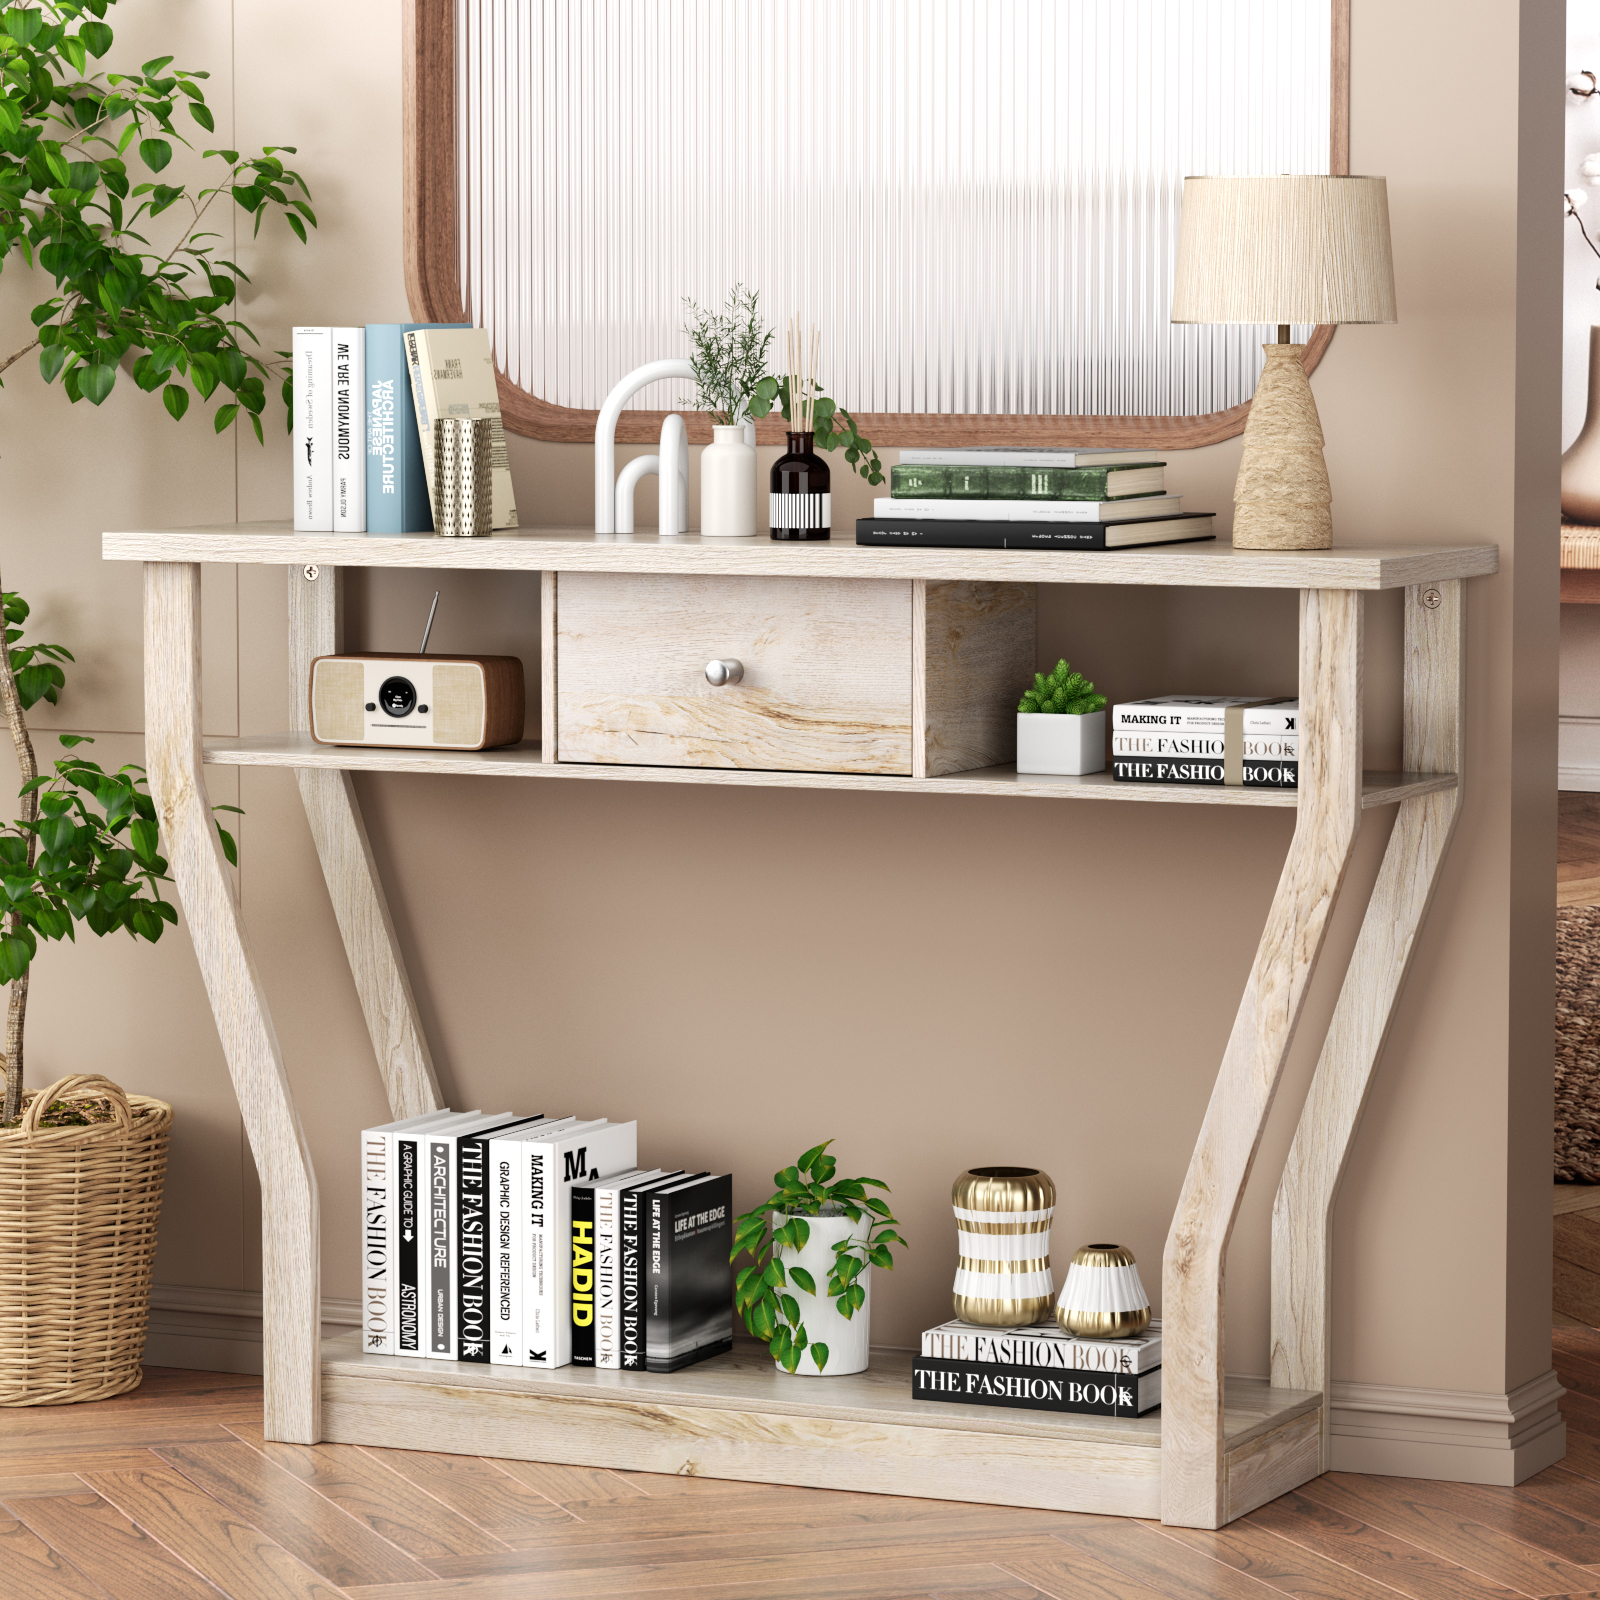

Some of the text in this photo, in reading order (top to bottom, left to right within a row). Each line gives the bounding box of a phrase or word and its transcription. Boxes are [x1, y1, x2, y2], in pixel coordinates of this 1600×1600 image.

[1121, 714, 1182, 725] MAKING IT
[1114, 737, 1296, 757] THE FASHIO BOOK
[1114, 762, 1296, 783] THE FASHIO BOOK
[403, 1151, 413, 1189] GRAPHIC
[499, 1161, 510, 1208] GRAPHIC
[531, 1154, 544, 1227] MAKING IT
[403, 1190, 414, 1219] GUIDE
[403, 1219, 414, 1229] TO
[433, 1155, 447, 1268] ARCHITECTURE
[674, 1217, 688, 1234] LIFE
[688, 1214, 697, 1230] AT
[696, 1211, 709, 1226] THE
[708, 1205, 726, 1222] EDGE
[366, 1136, 388, 1348] THE FASHION BOOK
[461, 1142, 484, 1357] THE FASHION BOOK
[500, 1211, 510, 1249] DESIGN
[652, 1199, 661, 1274] LIFE AT THE EDGE
[500, 1252, 511, 1321] REFERENCED
[573, 1220, 593, 1327] HADID
[599, 1192, 614, 1365] THE FASHION BOOK
[623, 1193, 639, 1367] THE FASHION BOOK
[401, 1283, 417, 1350] ASTRONOMY
[924, 1332, 1132, 1375] THE FASHION BOOK
[914, 1369, 1134, 1407] THE FASHION BOOK
